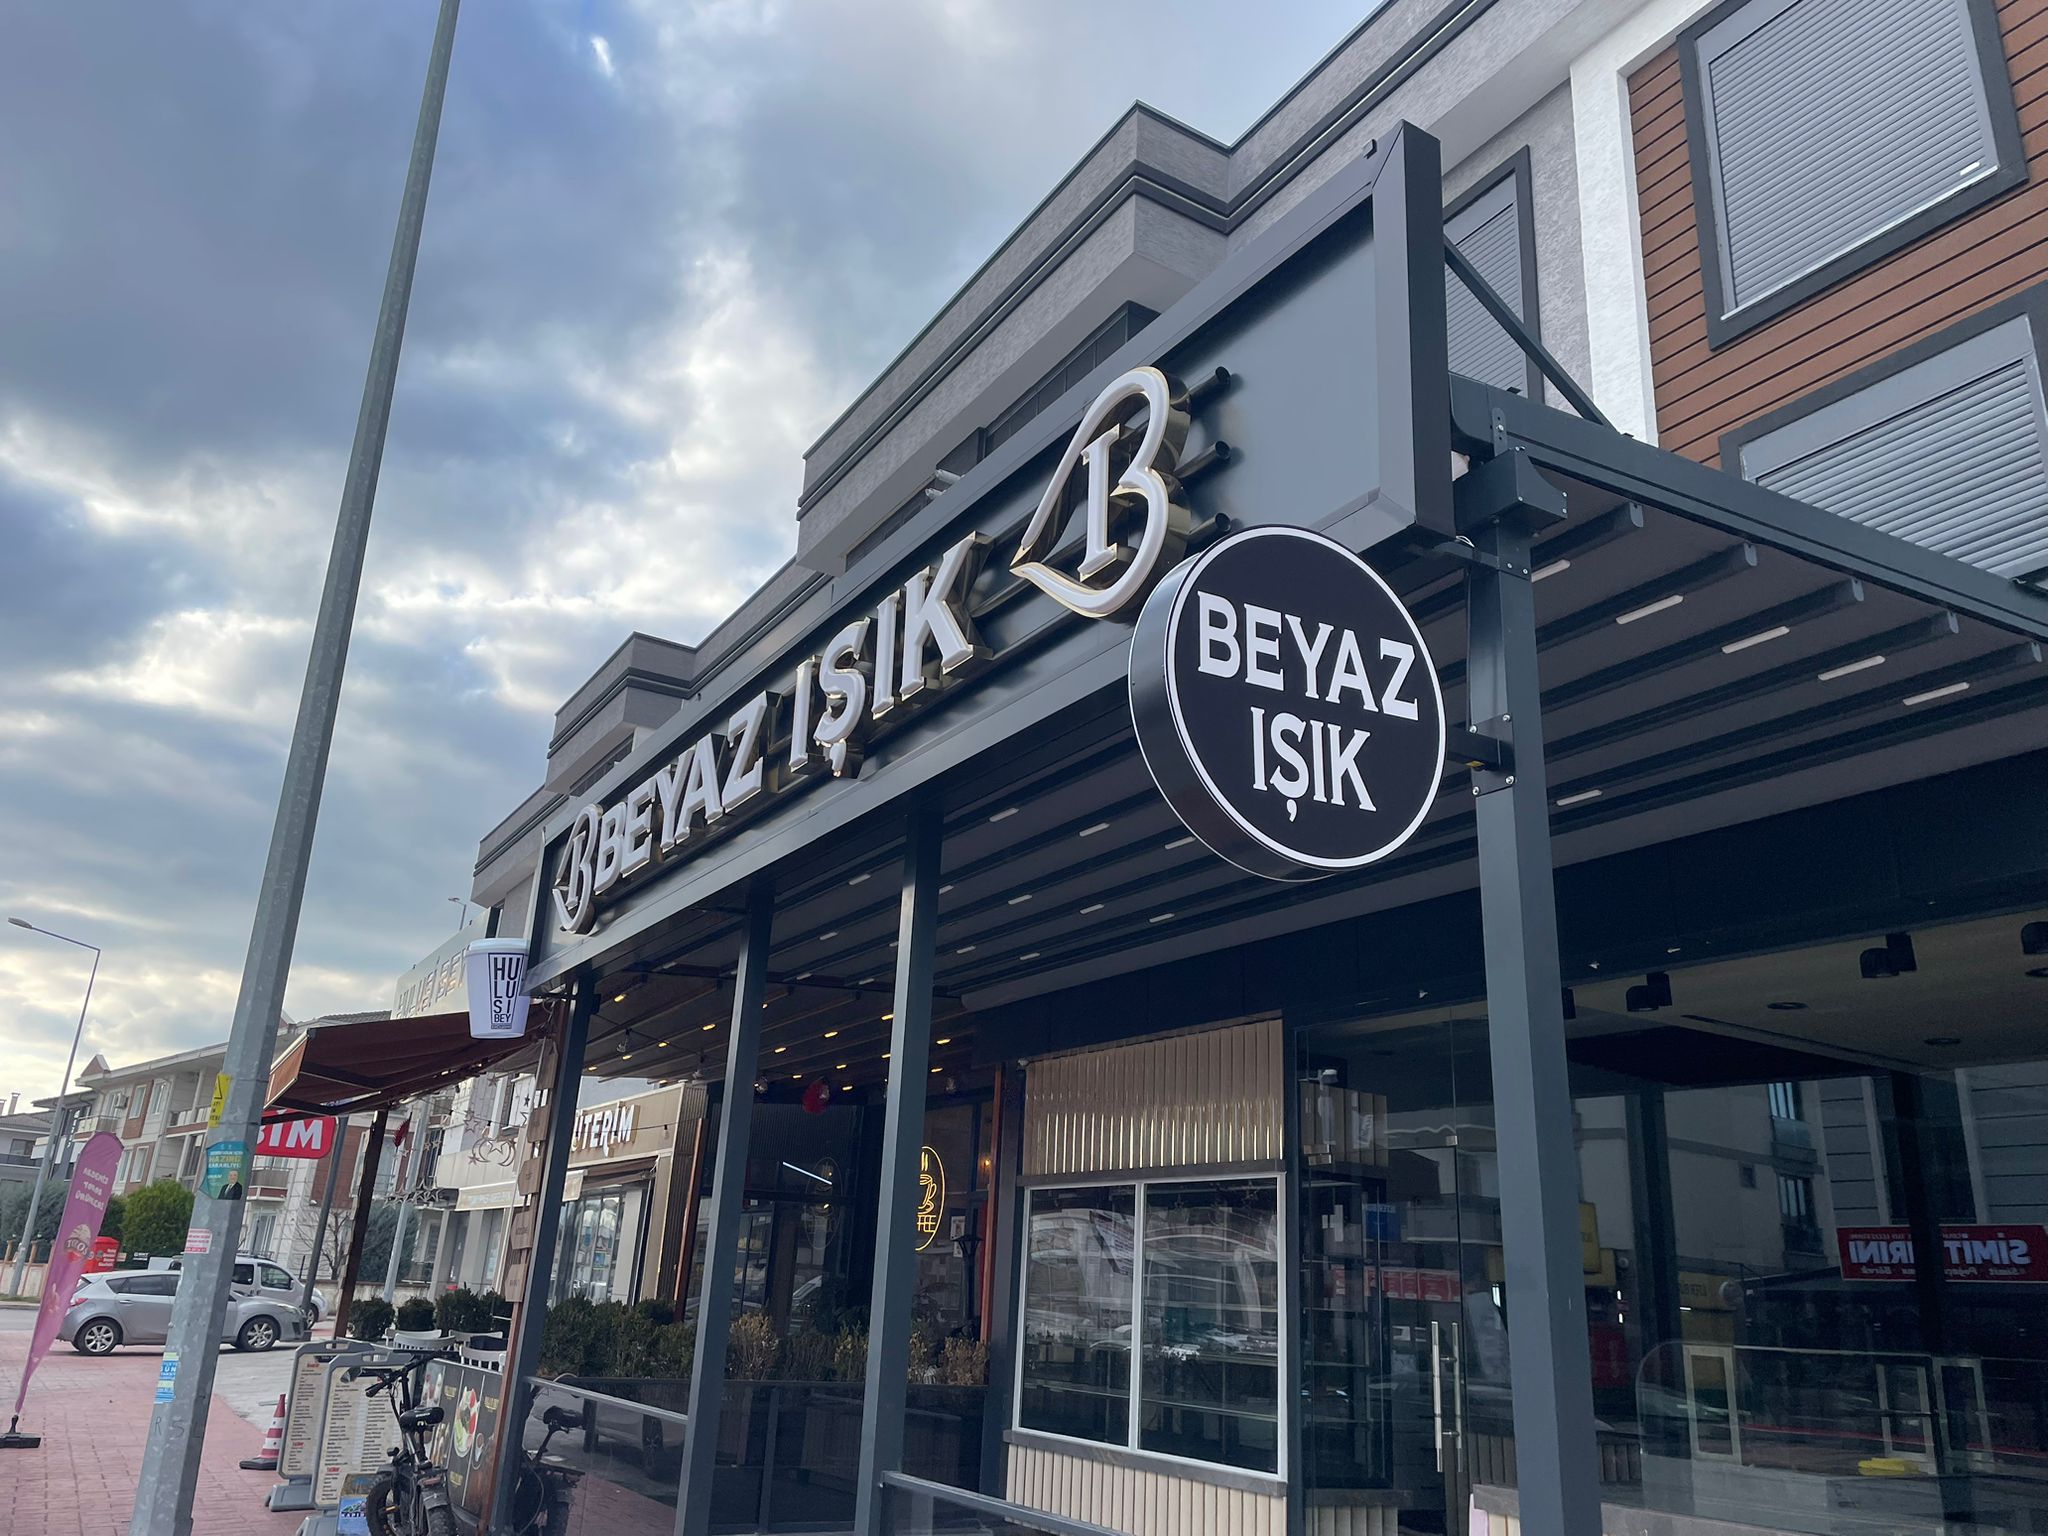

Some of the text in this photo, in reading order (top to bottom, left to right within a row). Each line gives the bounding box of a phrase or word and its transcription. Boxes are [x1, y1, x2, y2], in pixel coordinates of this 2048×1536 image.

[594, 691, 768, 895] BEYAZ
[789, 531, 978, 777] IŞIK
[1197, 590, 1419, 720] BEYAZ
[1250, 706, 1377, 822] IŞIK
[494, 1013, 512, 1023] BEY
[917, 1215, 937, 1232] FEE
